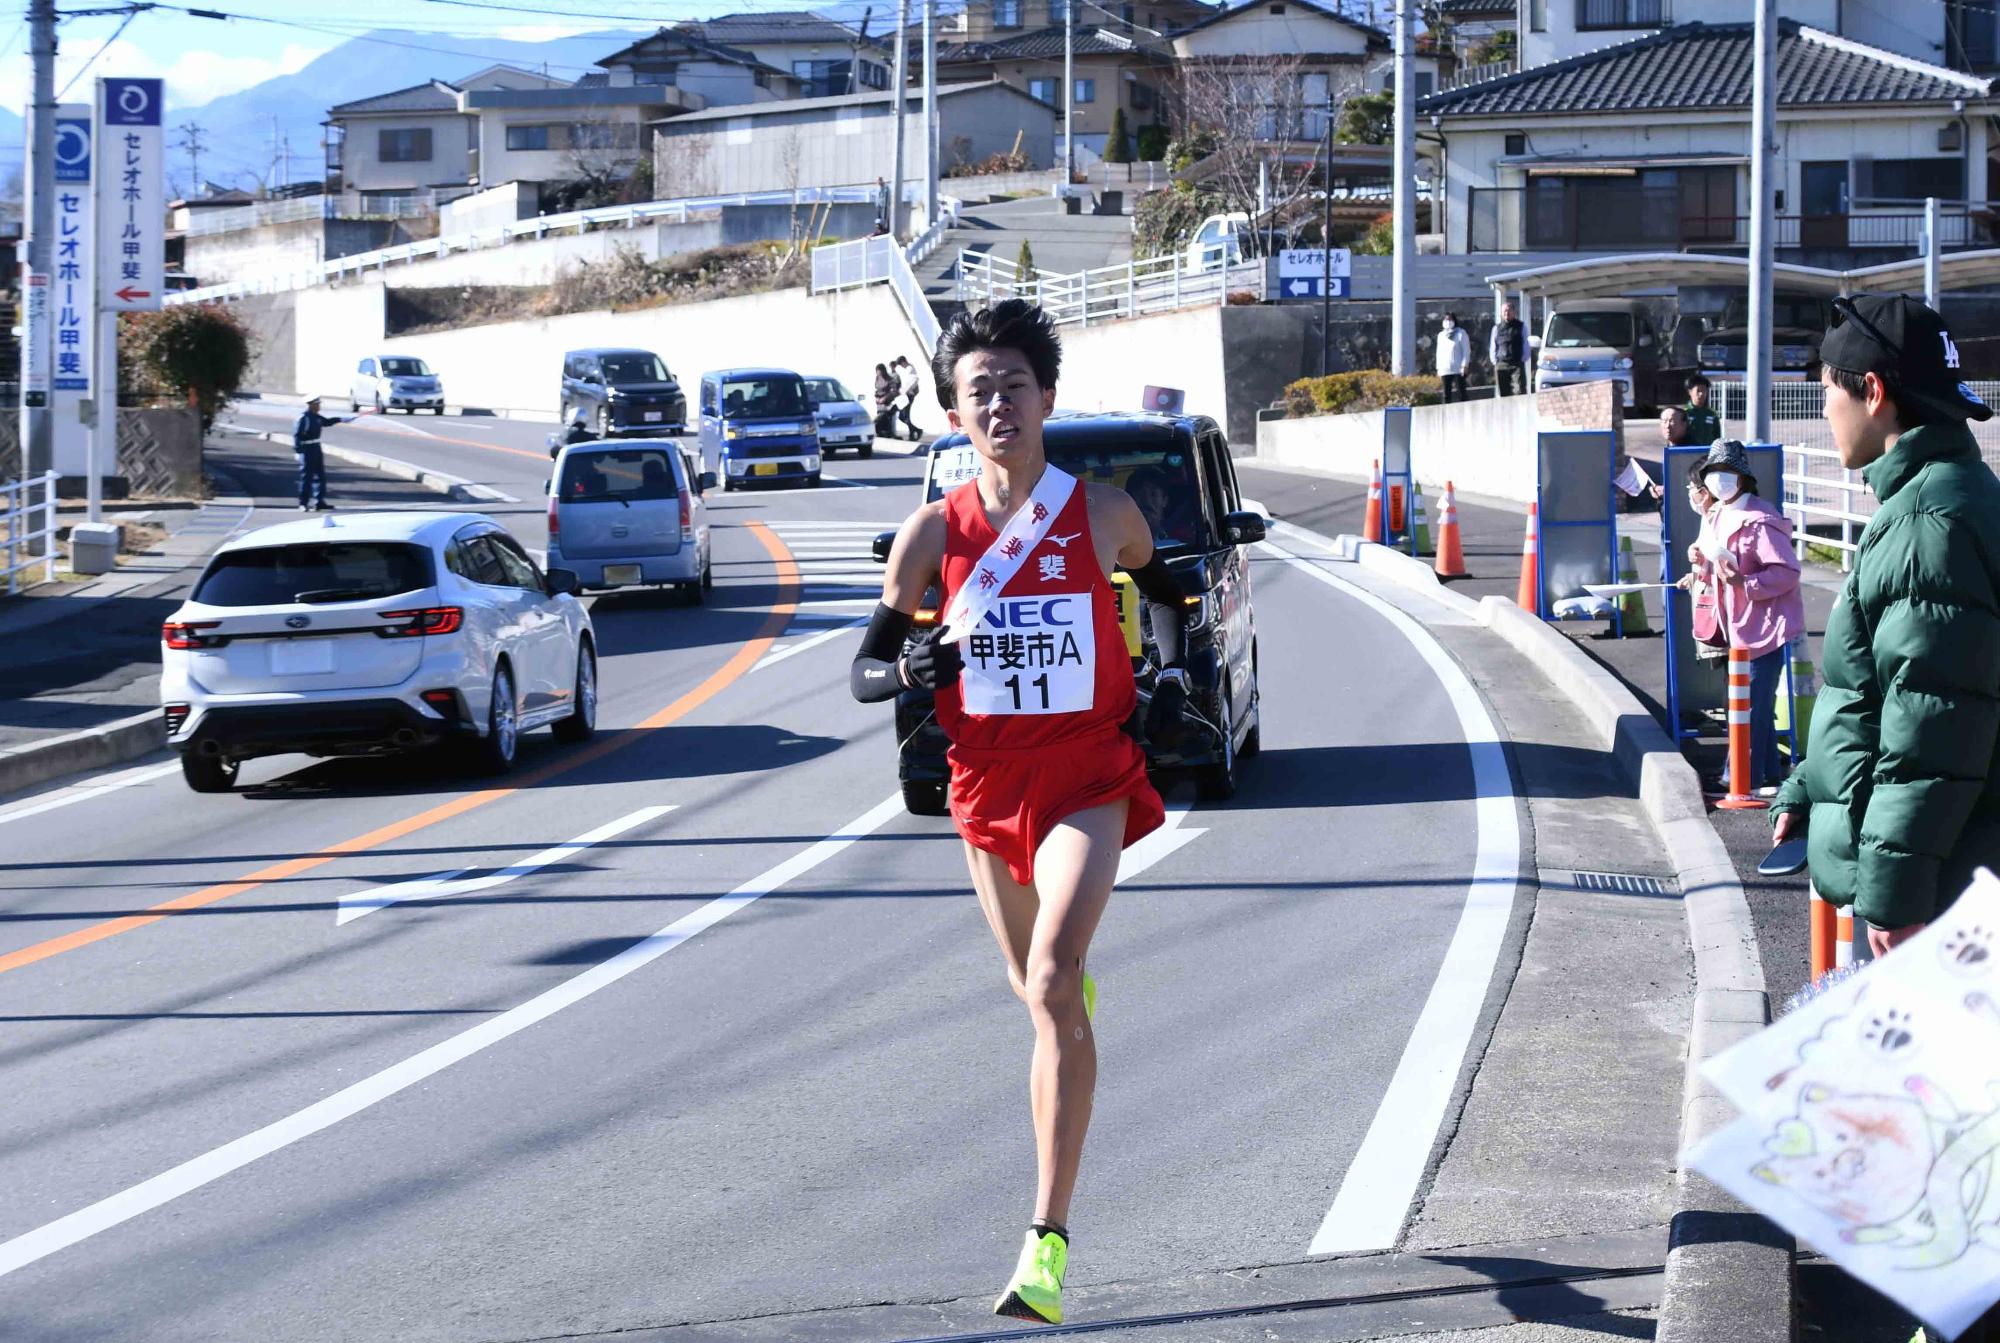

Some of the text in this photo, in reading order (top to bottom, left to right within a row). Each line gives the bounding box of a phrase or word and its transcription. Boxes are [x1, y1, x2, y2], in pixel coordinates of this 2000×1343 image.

[122, 131, 141, 280] セレオホール甲斐
[58, 193, 80, 374] セレオホール甲斐
[1939, 331, 1960, 368] LA
[957, 451, 974, 465] 11
[1038, 554, 1066, 582] 斐
[976, 598, 1073, 629] NEC
[970, 631, 1082, 670] 甲斐市A
[1005, 673, 1049, 710] 11
